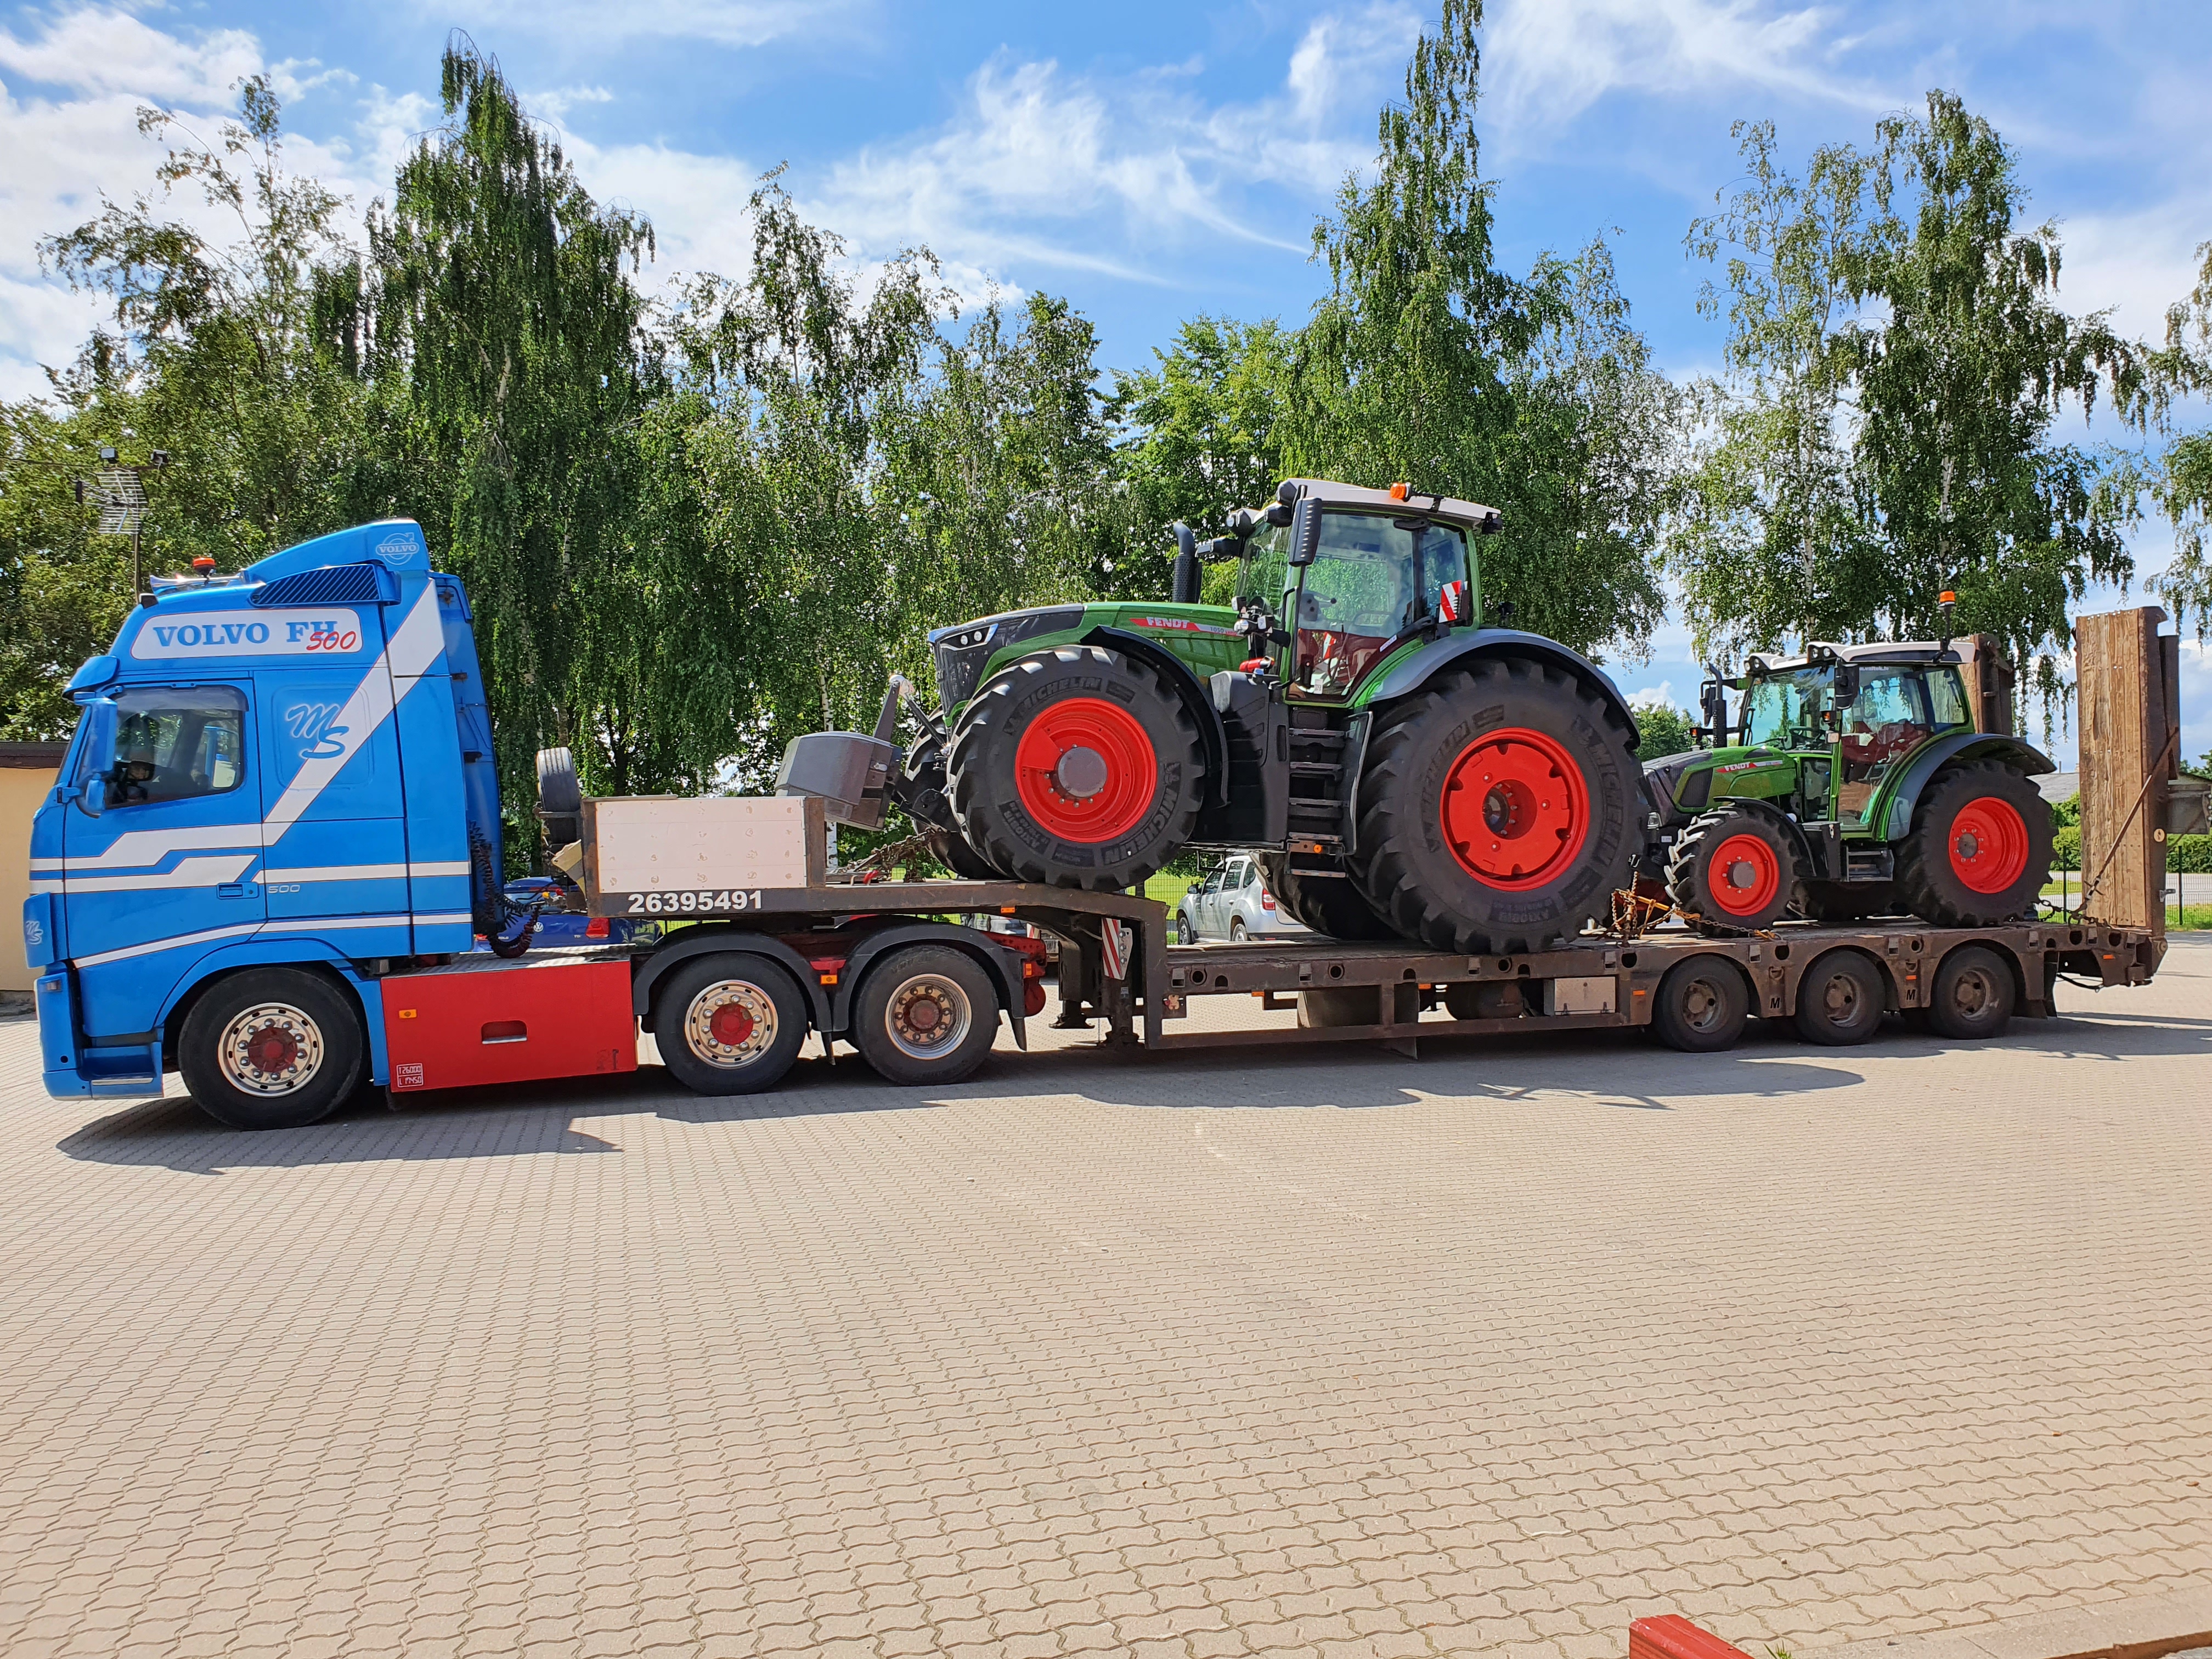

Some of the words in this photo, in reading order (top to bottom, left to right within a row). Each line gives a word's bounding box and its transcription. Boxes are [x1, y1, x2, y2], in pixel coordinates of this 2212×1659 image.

[379, 545, 417, 553] VOLVO
[1146, 616, 1190, 629] FENDT
[153, 622, 270, 647] VOLVO
[286, 620, 338, 643] FH
[306, 631, 357, 651] 500
[1016, 676, 1102, 718] MICHELIN
[1724, 761, 1751, 772] FENDT
[1104, 787, 1178, 865] MICHELIN
[268, 884, 301, 894] 500
[628, 890, 762, 913] 26395491
[1906, 989, 1916, 1000] M
[1770, 997, 1780, 1009] M
